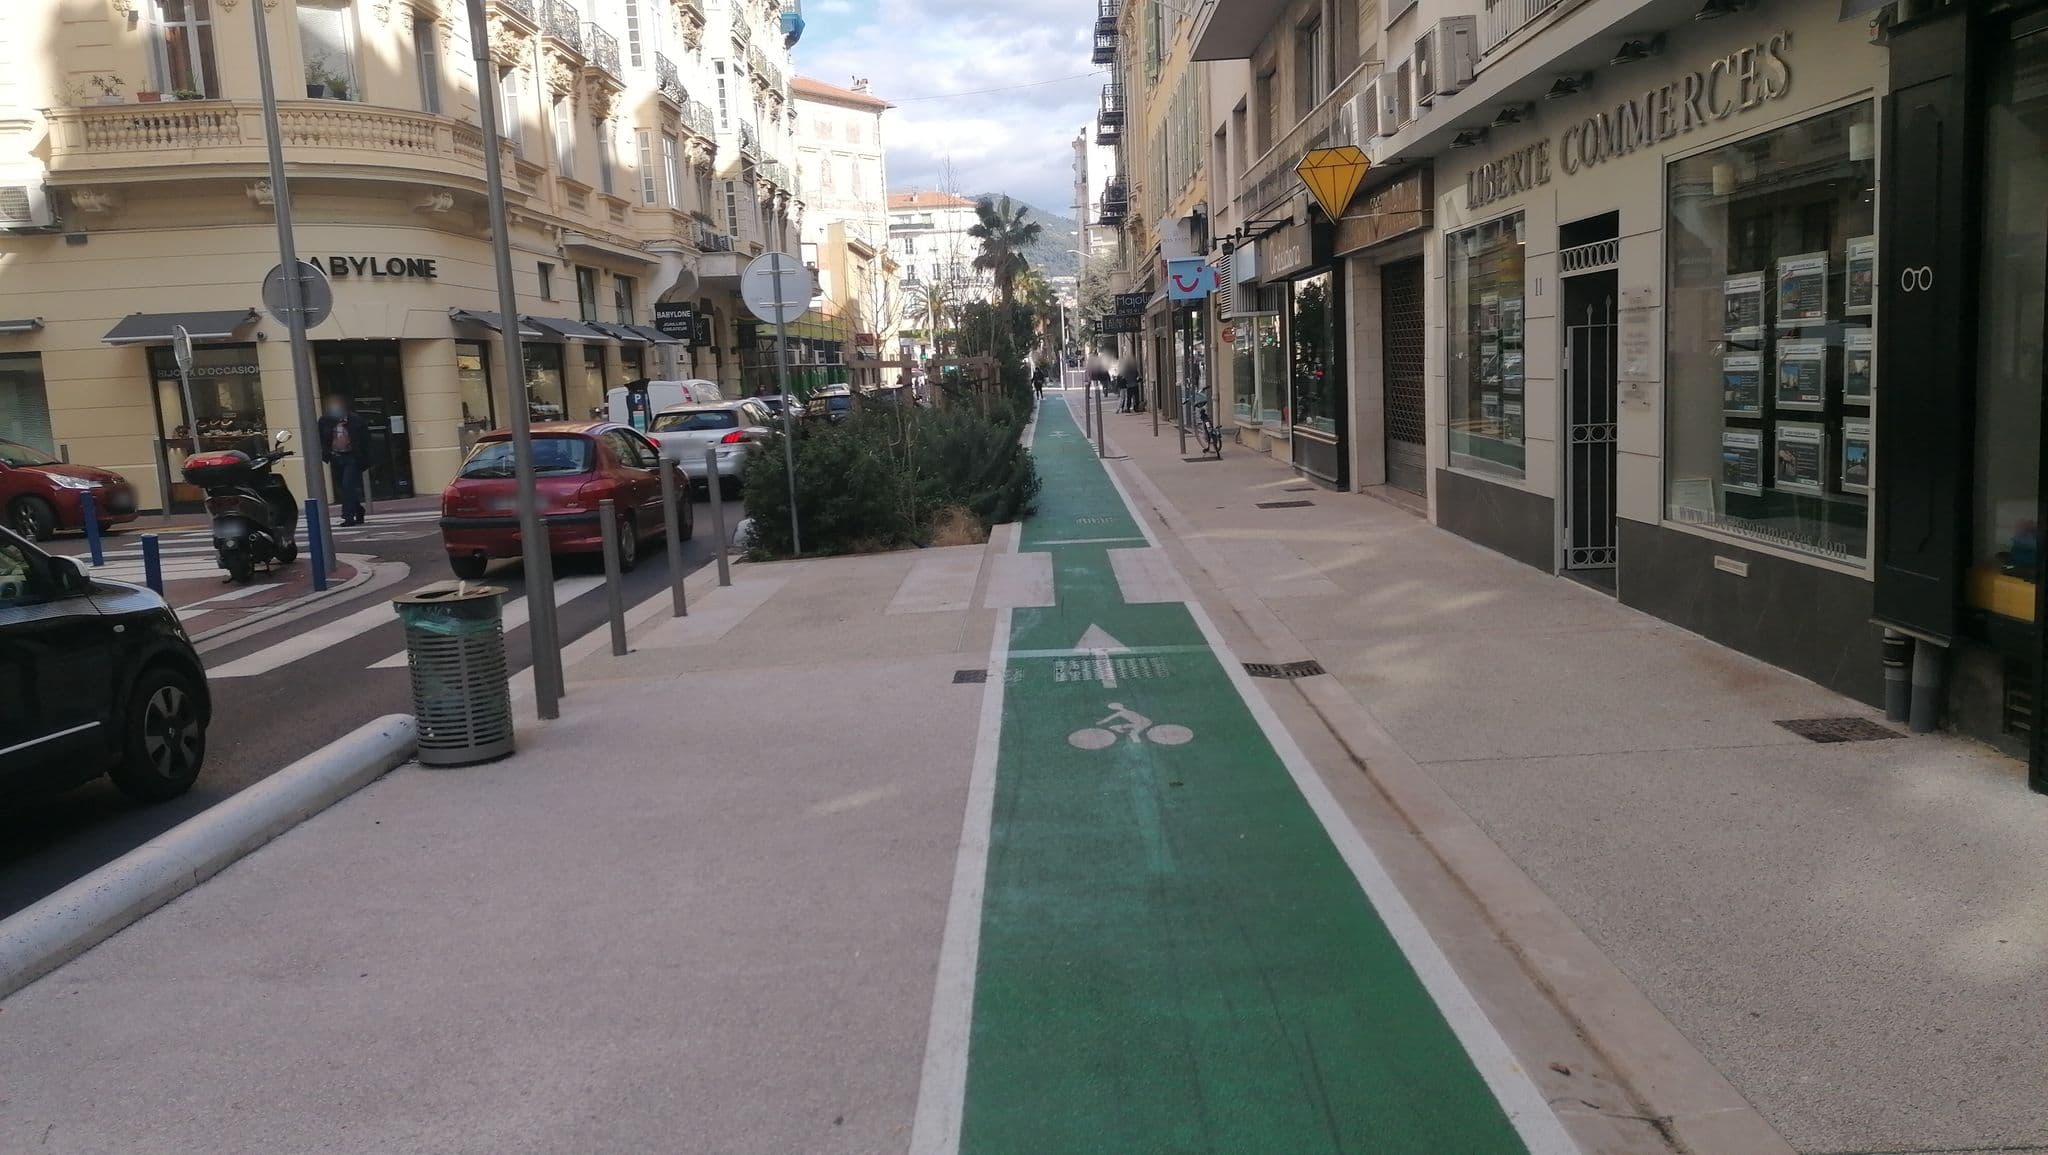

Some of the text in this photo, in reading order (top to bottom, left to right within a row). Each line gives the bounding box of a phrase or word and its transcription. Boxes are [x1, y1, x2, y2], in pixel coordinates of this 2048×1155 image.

[1466, 138, 1552, 210] LIBERTE
[1559, 30, 1793, 176] COMMERCES
[296, 256, 437, 278] ABYLONE
[656, 310, 691, 319] BABYLONE
[157, 367, 196, 377] BIJOX
[634, 393, 641, 404] P
